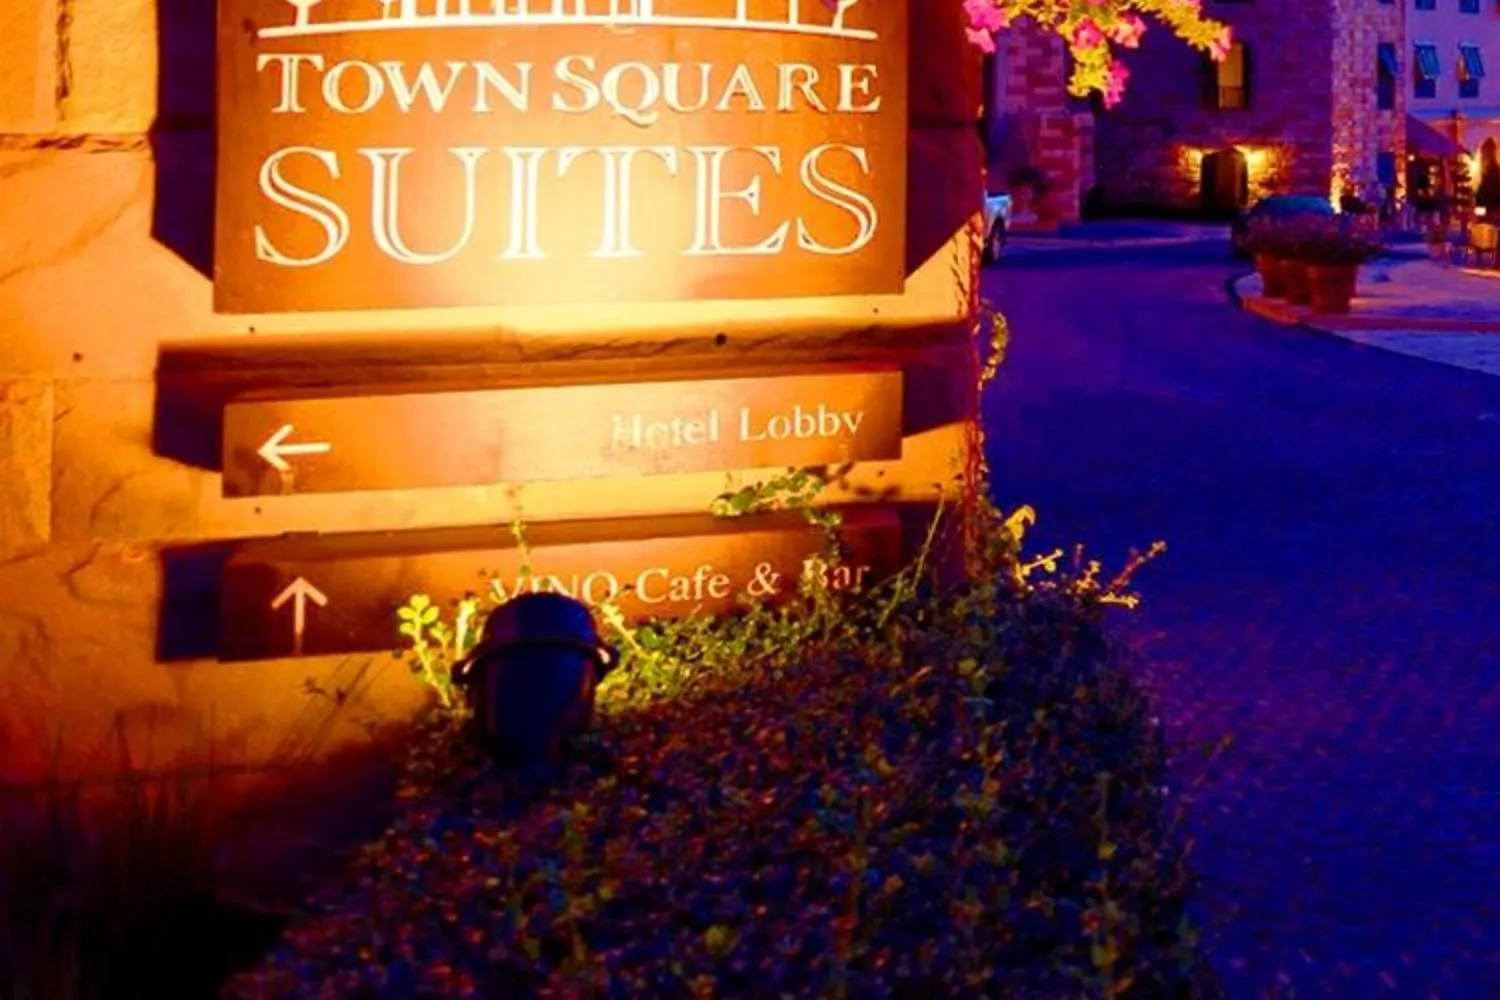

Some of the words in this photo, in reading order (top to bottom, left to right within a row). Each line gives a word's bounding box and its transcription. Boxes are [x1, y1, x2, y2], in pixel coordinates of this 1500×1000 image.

[256, 53, 535, 114] TOWN
[552, 54, 882, 126] SQUARE
[254, 142, 880, 268] SUITES
[611, 408, 720, 449] Hotel
[739, 403, 864, 447] Lobby
[635, 564, 731, 604] Cafe
[746, 561, 782, 597] &
